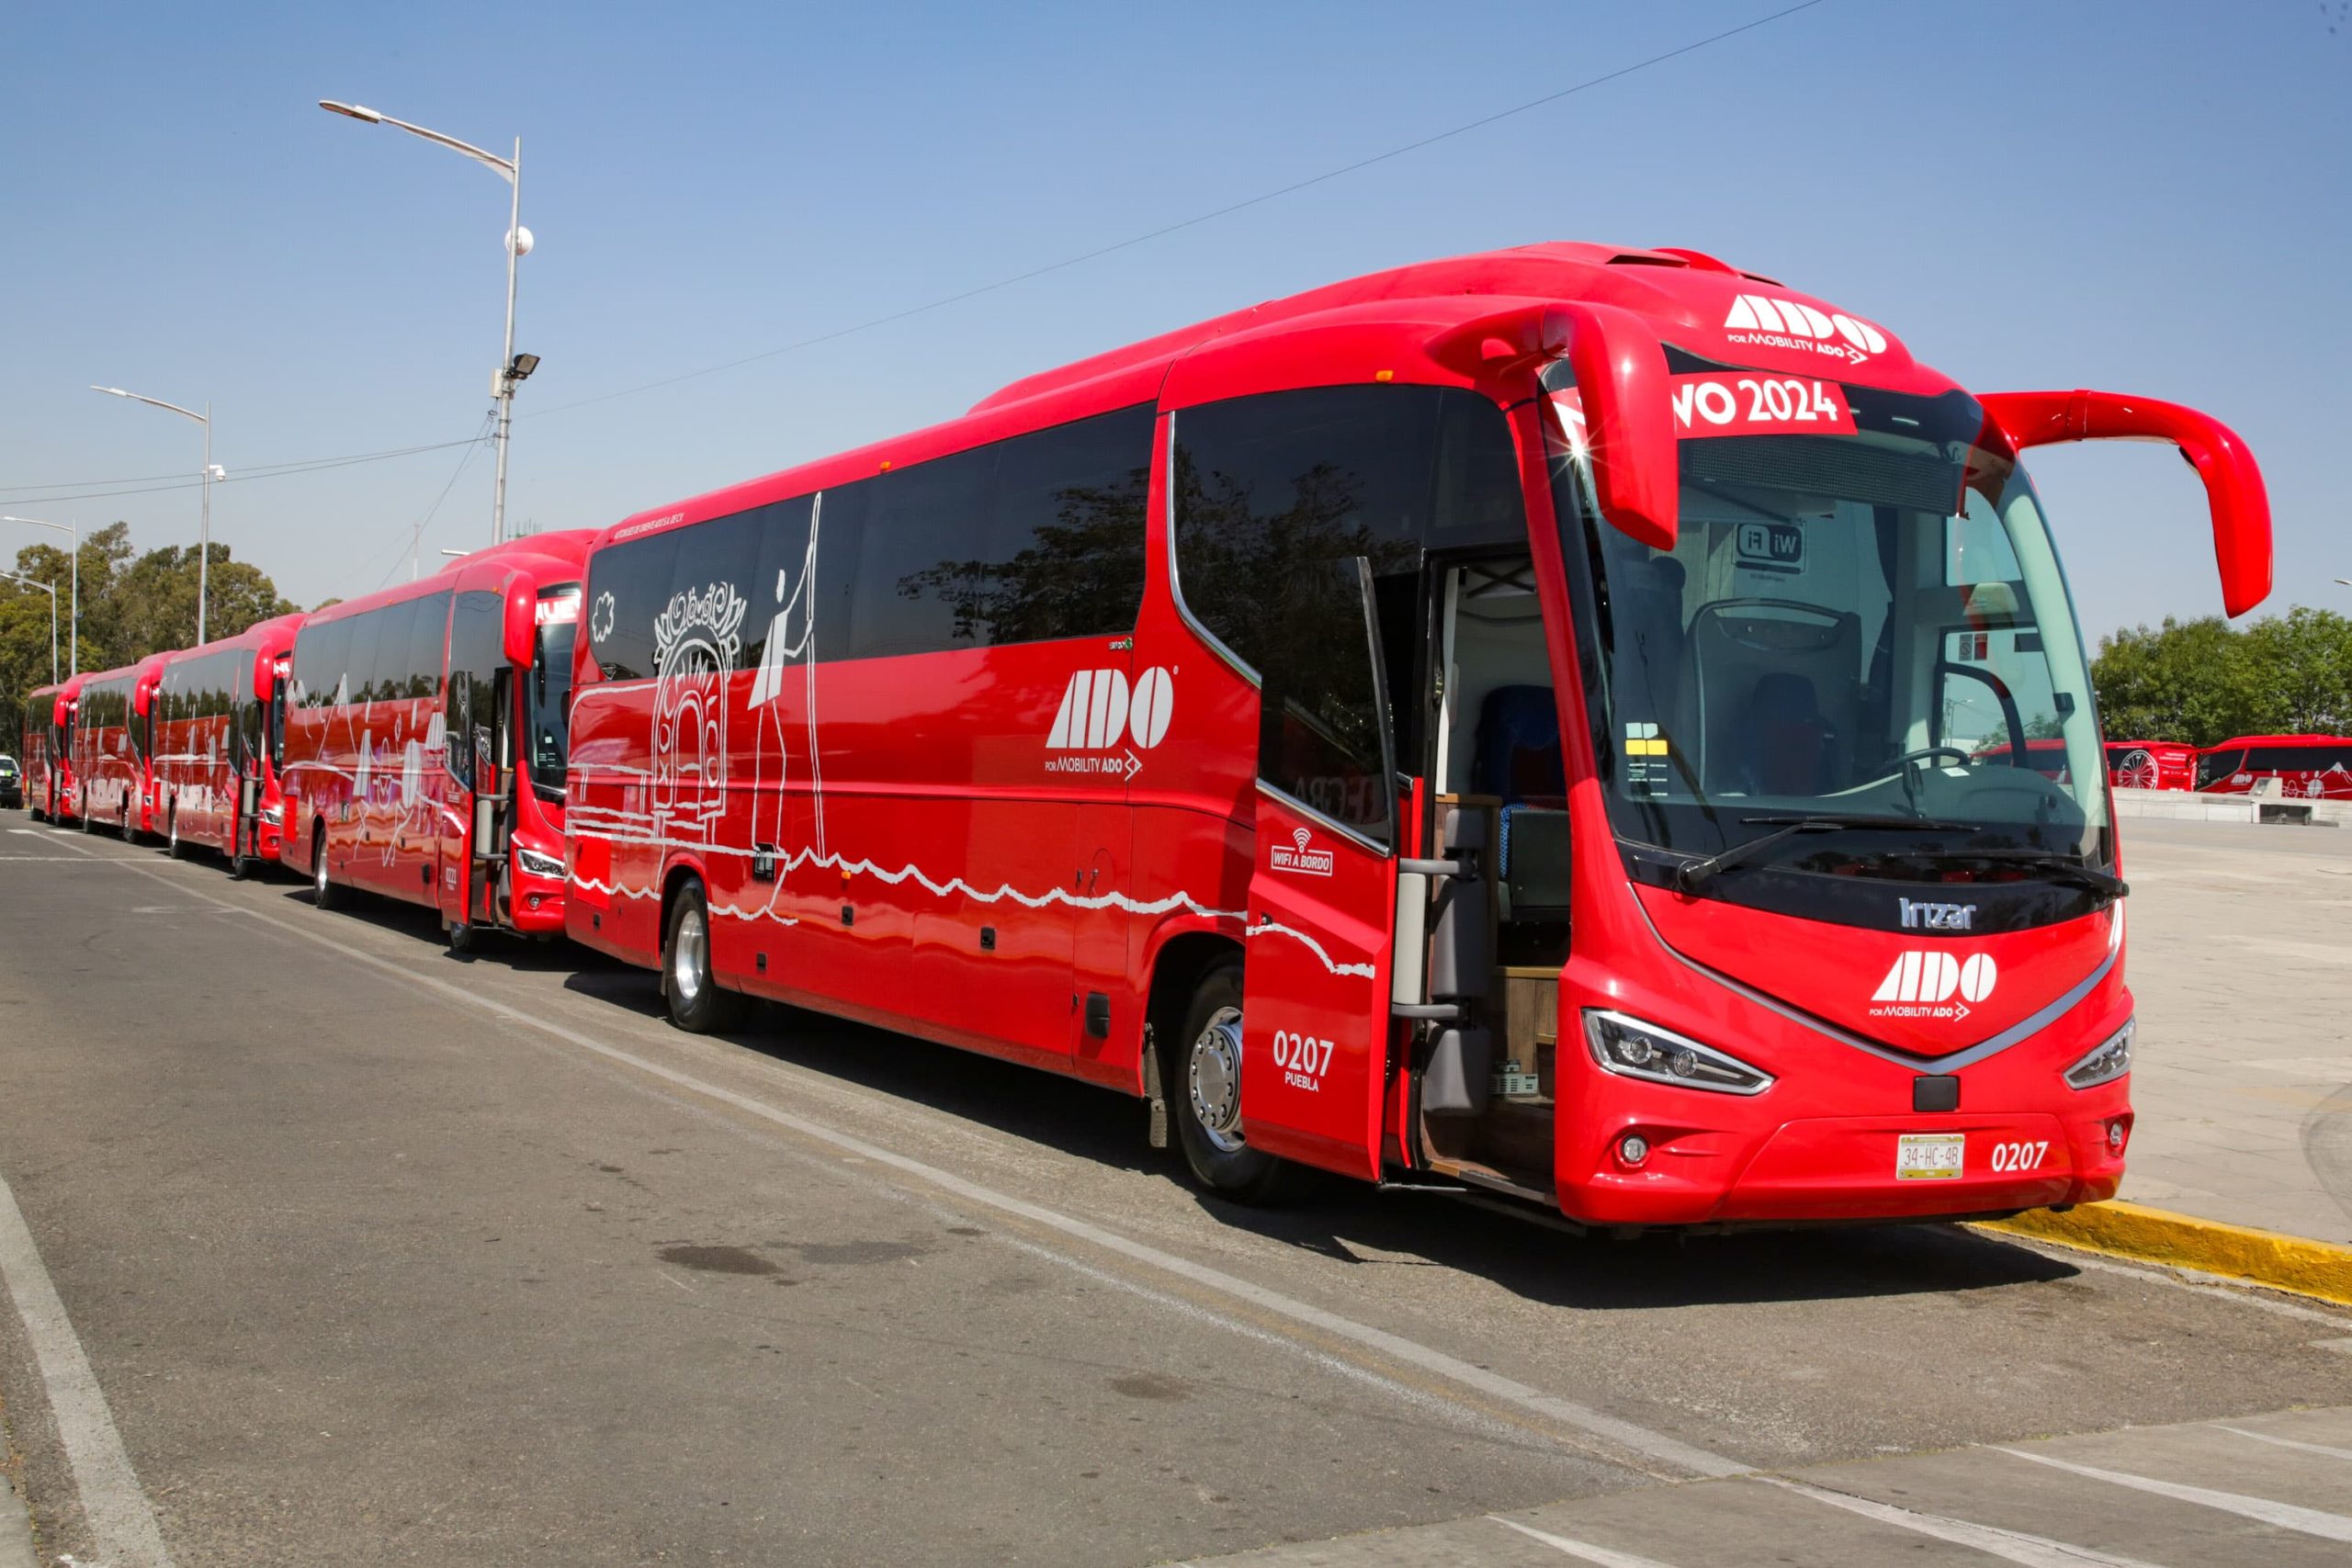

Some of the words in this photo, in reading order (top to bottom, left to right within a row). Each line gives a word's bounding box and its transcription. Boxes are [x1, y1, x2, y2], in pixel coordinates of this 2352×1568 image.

[1724, 293, 1887, 355] ADO
[1727, 333, 1747, 344] POR
[1748, 333, 1814, 352] MOBILITY
[1816, 343, 1845, 357] ADO
[1738, 379, 1838, 422] 2024
[1046, 666, 1174, 750] ADO
[1045, 761, 1057, 772] POR
[1057, 756, 1101, 773] MOBILITY
[1102, 758, 1123, 773] ADO
[1273, 852, 1292, 867] WIFI
[1293, 854, 1299, 866] A
[1300, 855, 1329, 871] BORDO
[1871, 951, 1997, 1003] ADO
[1870, 1008, 1883, 1016] POR
[1883, 1005, 1931, 1017] MOBILITY
[1932, 1007, 1953, 1017] ADO
[1273, 1030, 1335, 1077] 0207
[1284, 1071, 1319, 1092] PUEBLA
[1991, 1141, 2049, 1172] 0207
